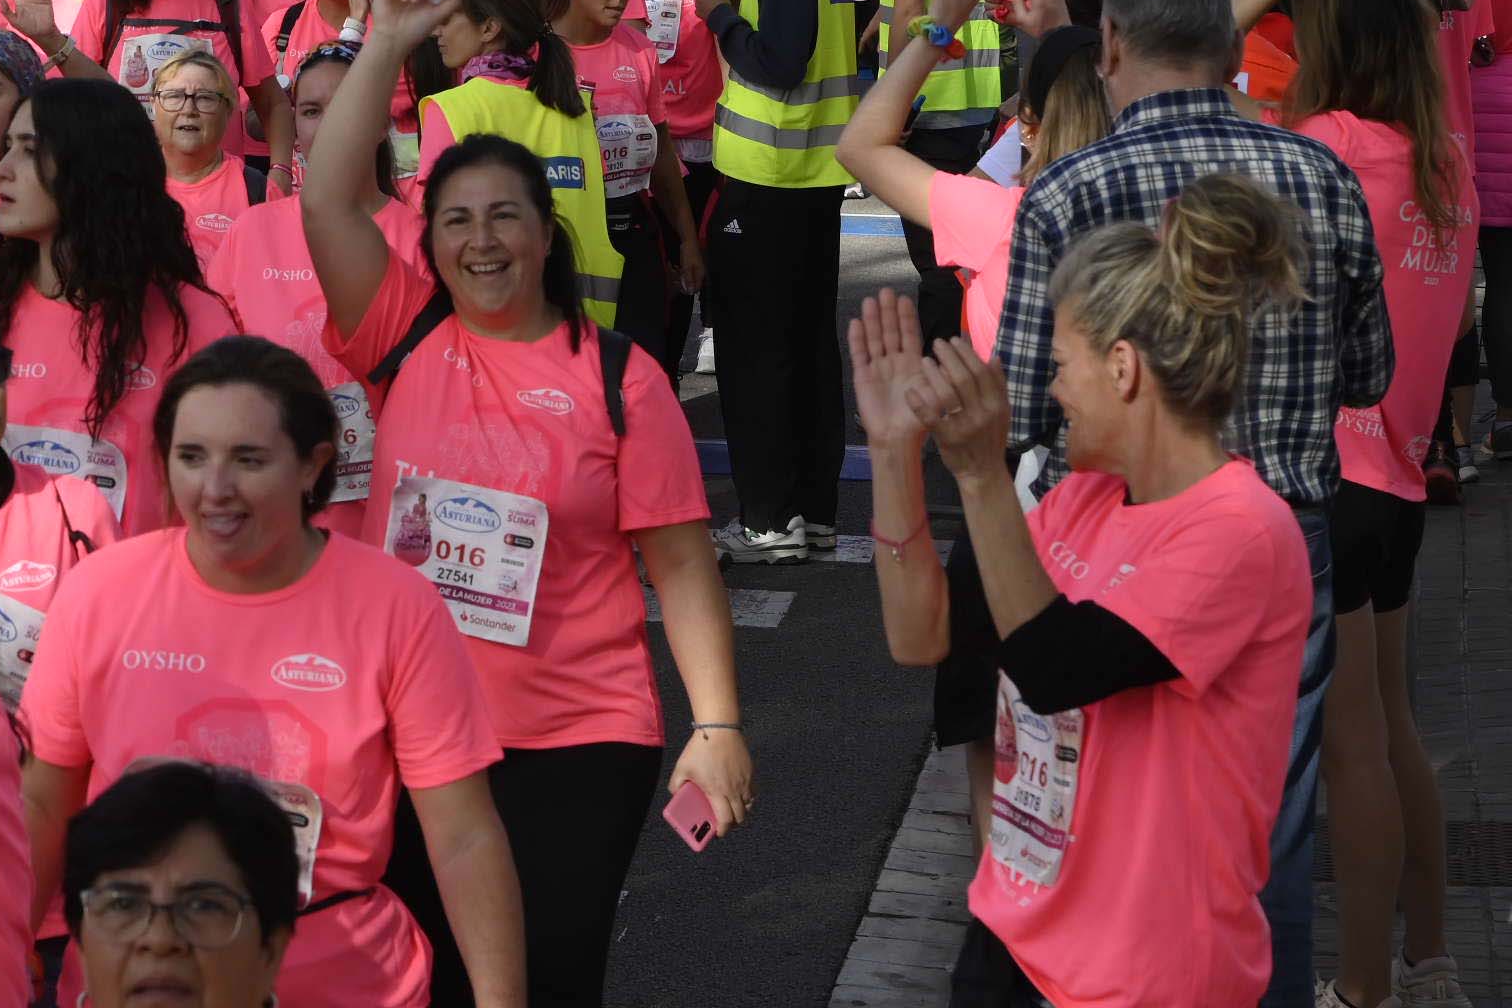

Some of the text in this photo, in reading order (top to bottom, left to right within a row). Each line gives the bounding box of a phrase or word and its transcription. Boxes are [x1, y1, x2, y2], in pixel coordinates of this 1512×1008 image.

[604, 146, 629, 161] 016
[546, 165, 581, 180] ARIS
[1400, 248, 1458, 274] MUJER
[263, 267, 313, 281] OYSHO
[16, 451, 75, 470] ASTURIANA
[439, 506, 496, 529] ASTURIANA
[435, 539, 486, 567] 016
[437, 567, 474, 586] 27541
[469, 613, 517, 633] Santander
[122, 649, 206, 673] OYSHO
[277, 665, 340, 684] ASTURIANA
